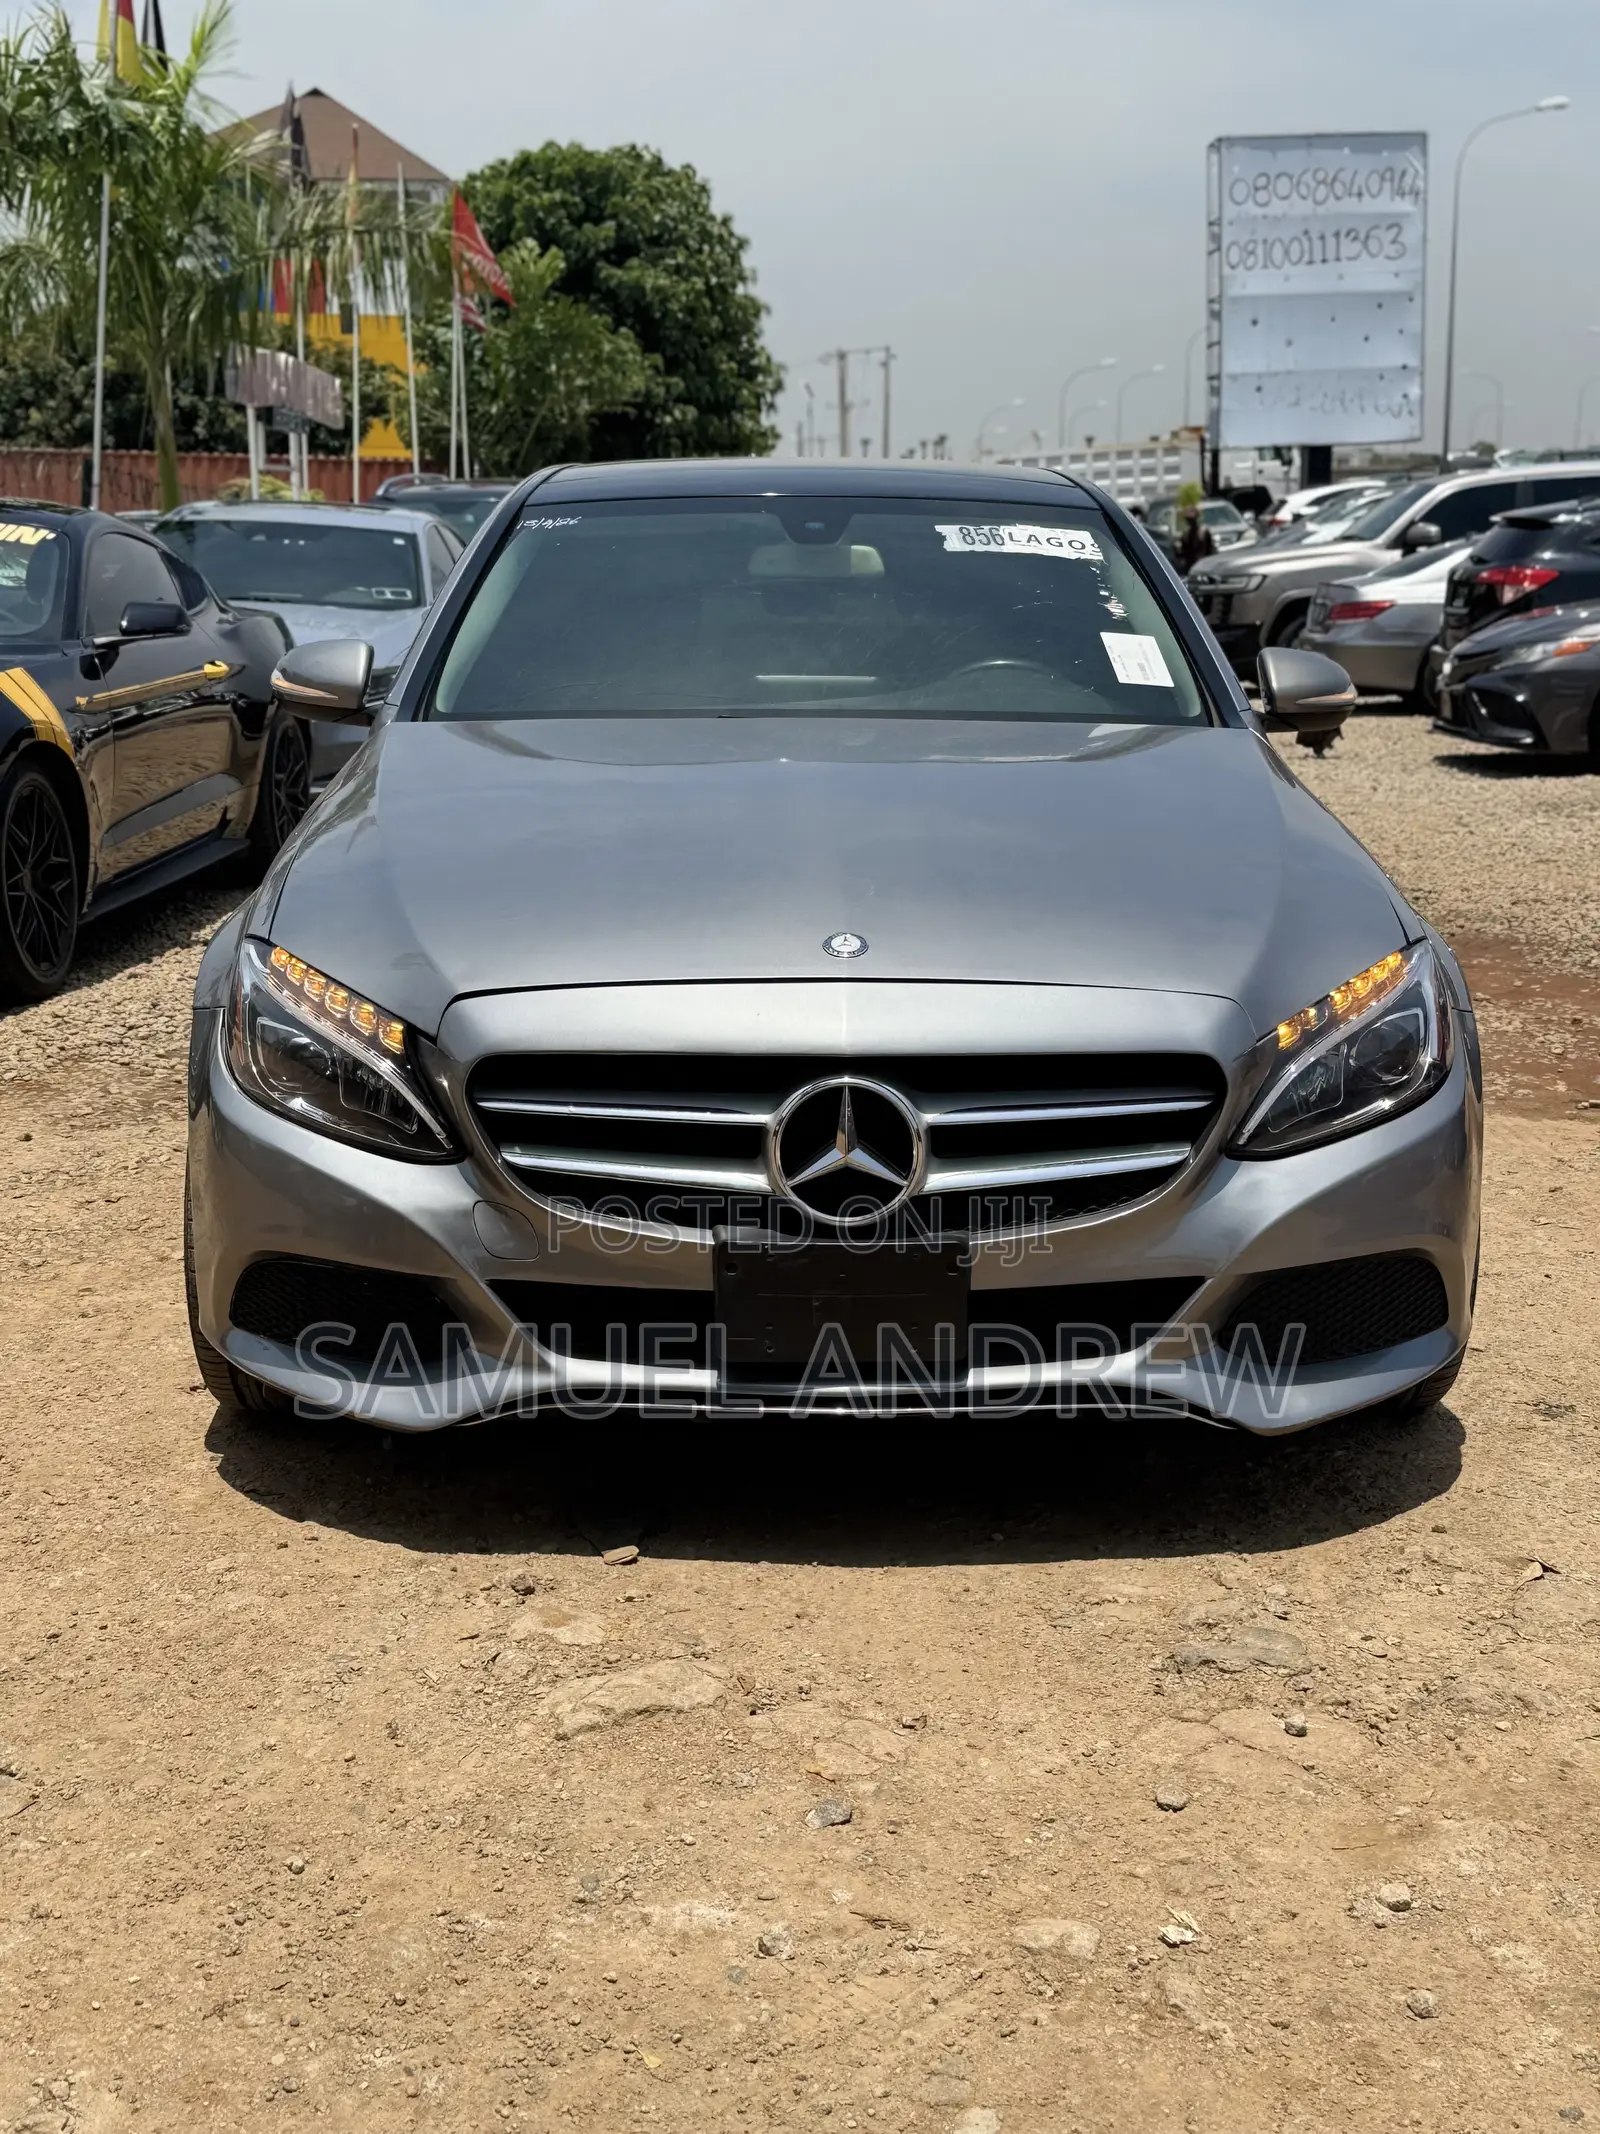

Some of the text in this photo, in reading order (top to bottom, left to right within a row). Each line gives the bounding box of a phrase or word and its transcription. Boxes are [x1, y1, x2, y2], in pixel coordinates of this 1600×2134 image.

[1229, 165, 1421, 207] 08068640944
[1225, 222, 1407, 270] 08100111363
[958, 526, 1005, 546] 856
